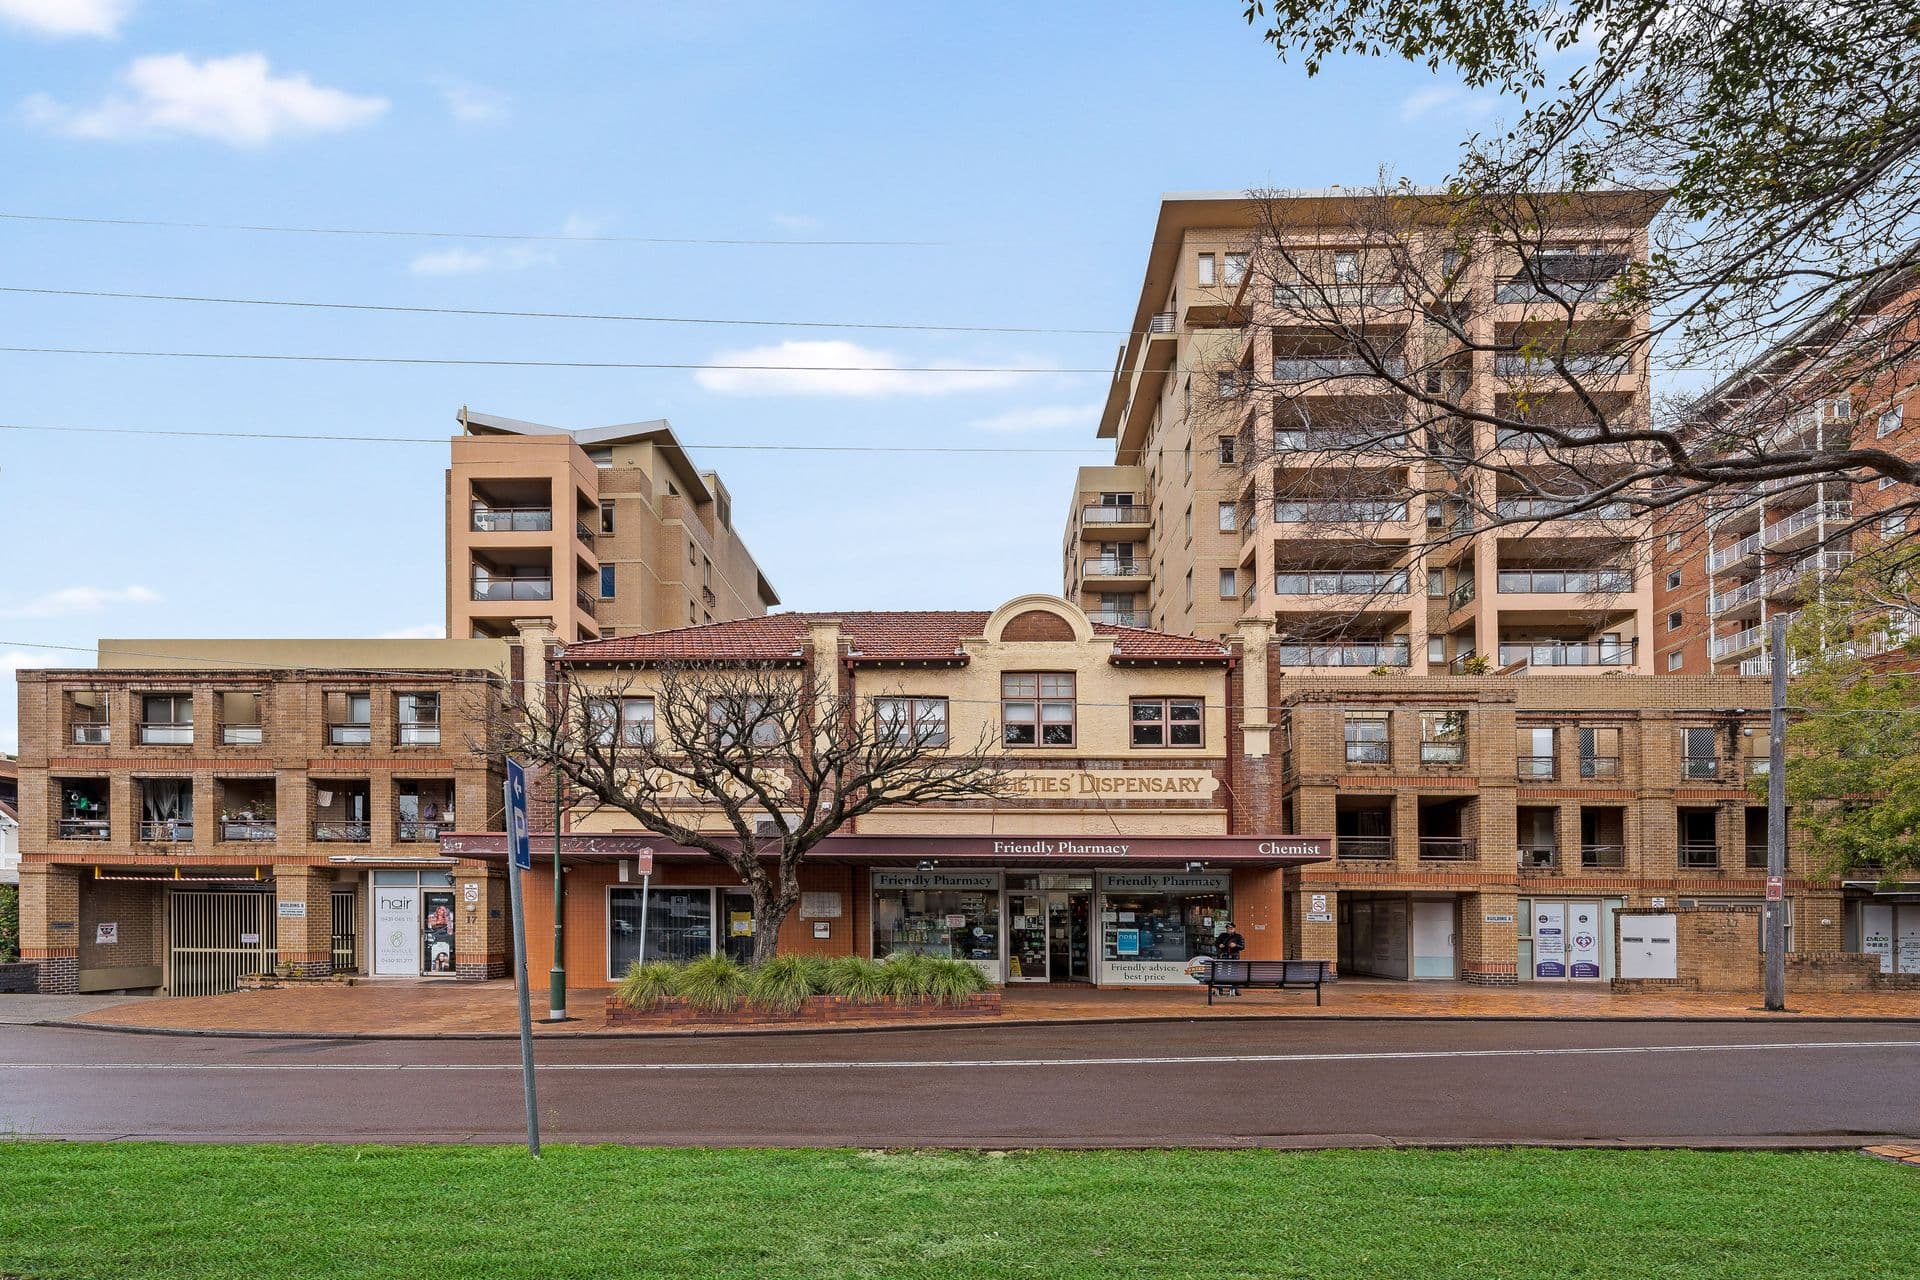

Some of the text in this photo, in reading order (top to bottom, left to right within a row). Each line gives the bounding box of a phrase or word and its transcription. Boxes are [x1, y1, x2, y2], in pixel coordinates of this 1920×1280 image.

[1079, 773, 1204, 794] DISPENSARY
[993, 841, 1129, 856] Friendly Pharmacy
[1258, 842, 1321, 855] Chemist
[880, 875, 993, 888] Friendly Pharmacy
[1107, 875, 1223, 888] Friendly Pharmacy
[381, 896, 413, 910] hair
[1111, 963, 1147, 972] Friendly
[1149, 963, 1179, 972] advice,
[1124, 972, 1166, 982] best price
